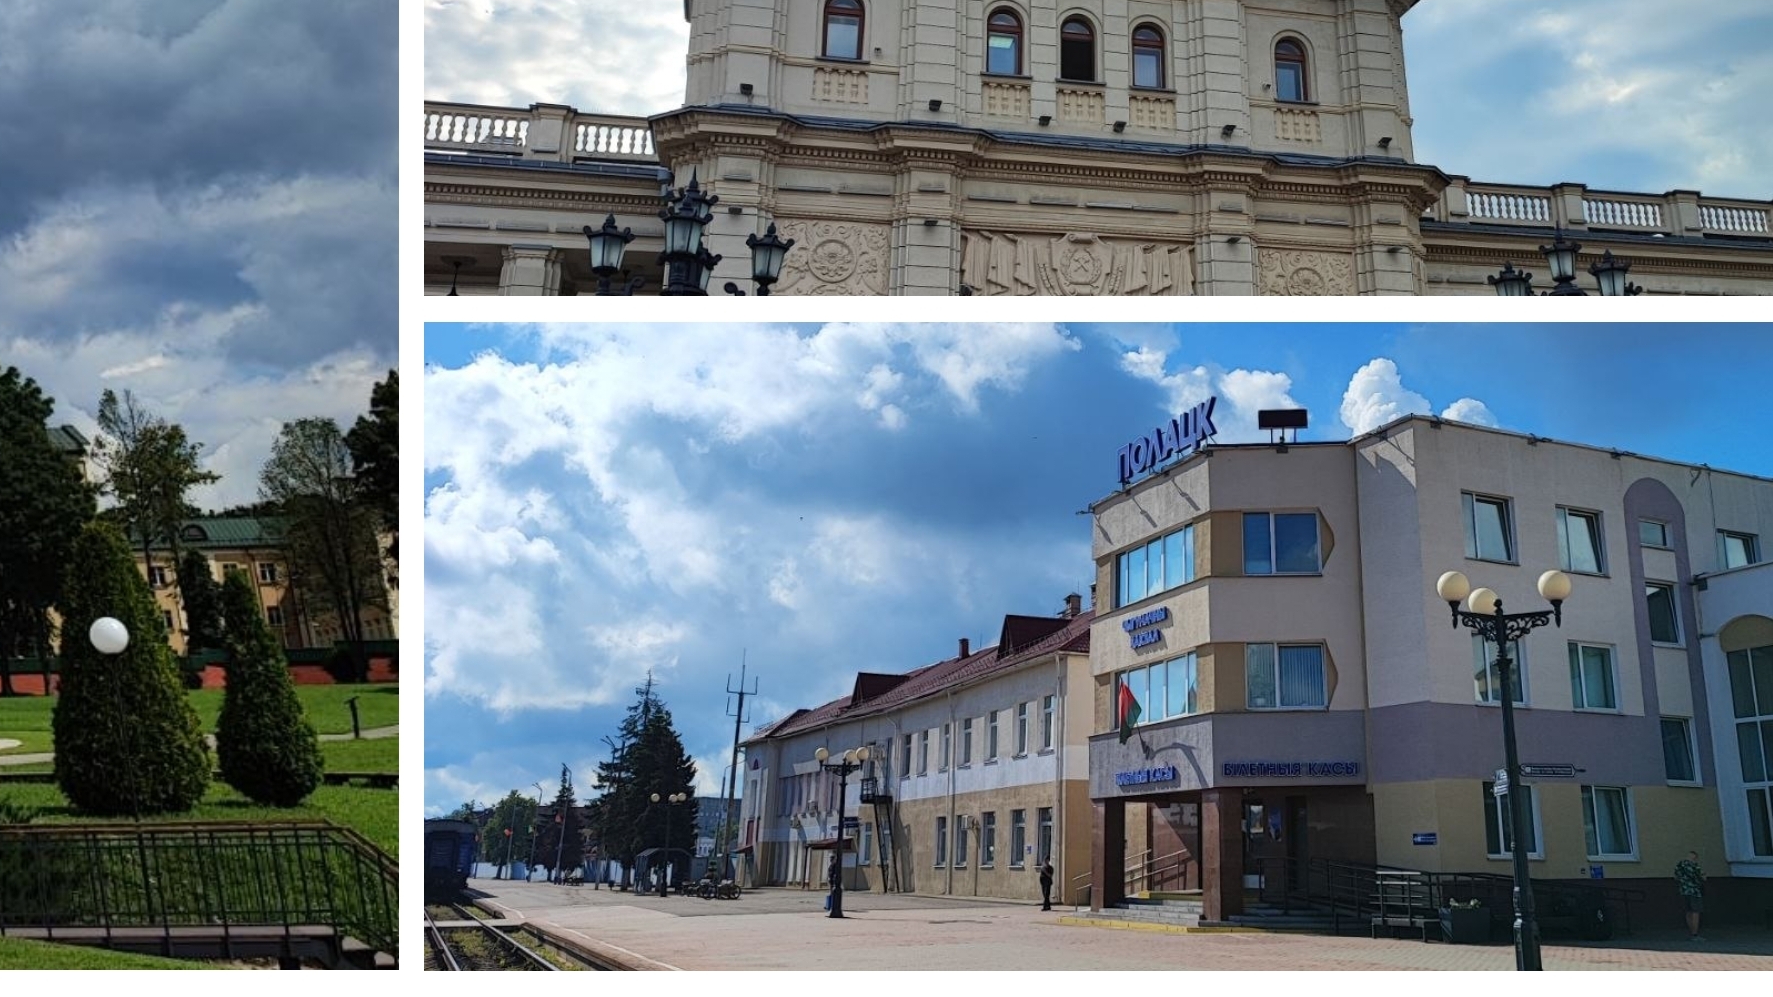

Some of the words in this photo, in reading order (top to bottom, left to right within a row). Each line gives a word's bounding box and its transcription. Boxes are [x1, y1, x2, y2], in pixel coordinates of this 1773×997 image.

[1116, 396, 1218, 483] ПОЛАЦК
[1223, 763, 1301, 776] БІЛЕТНЫЯ
[1308, 762, 1360, 775] КАСЫ
